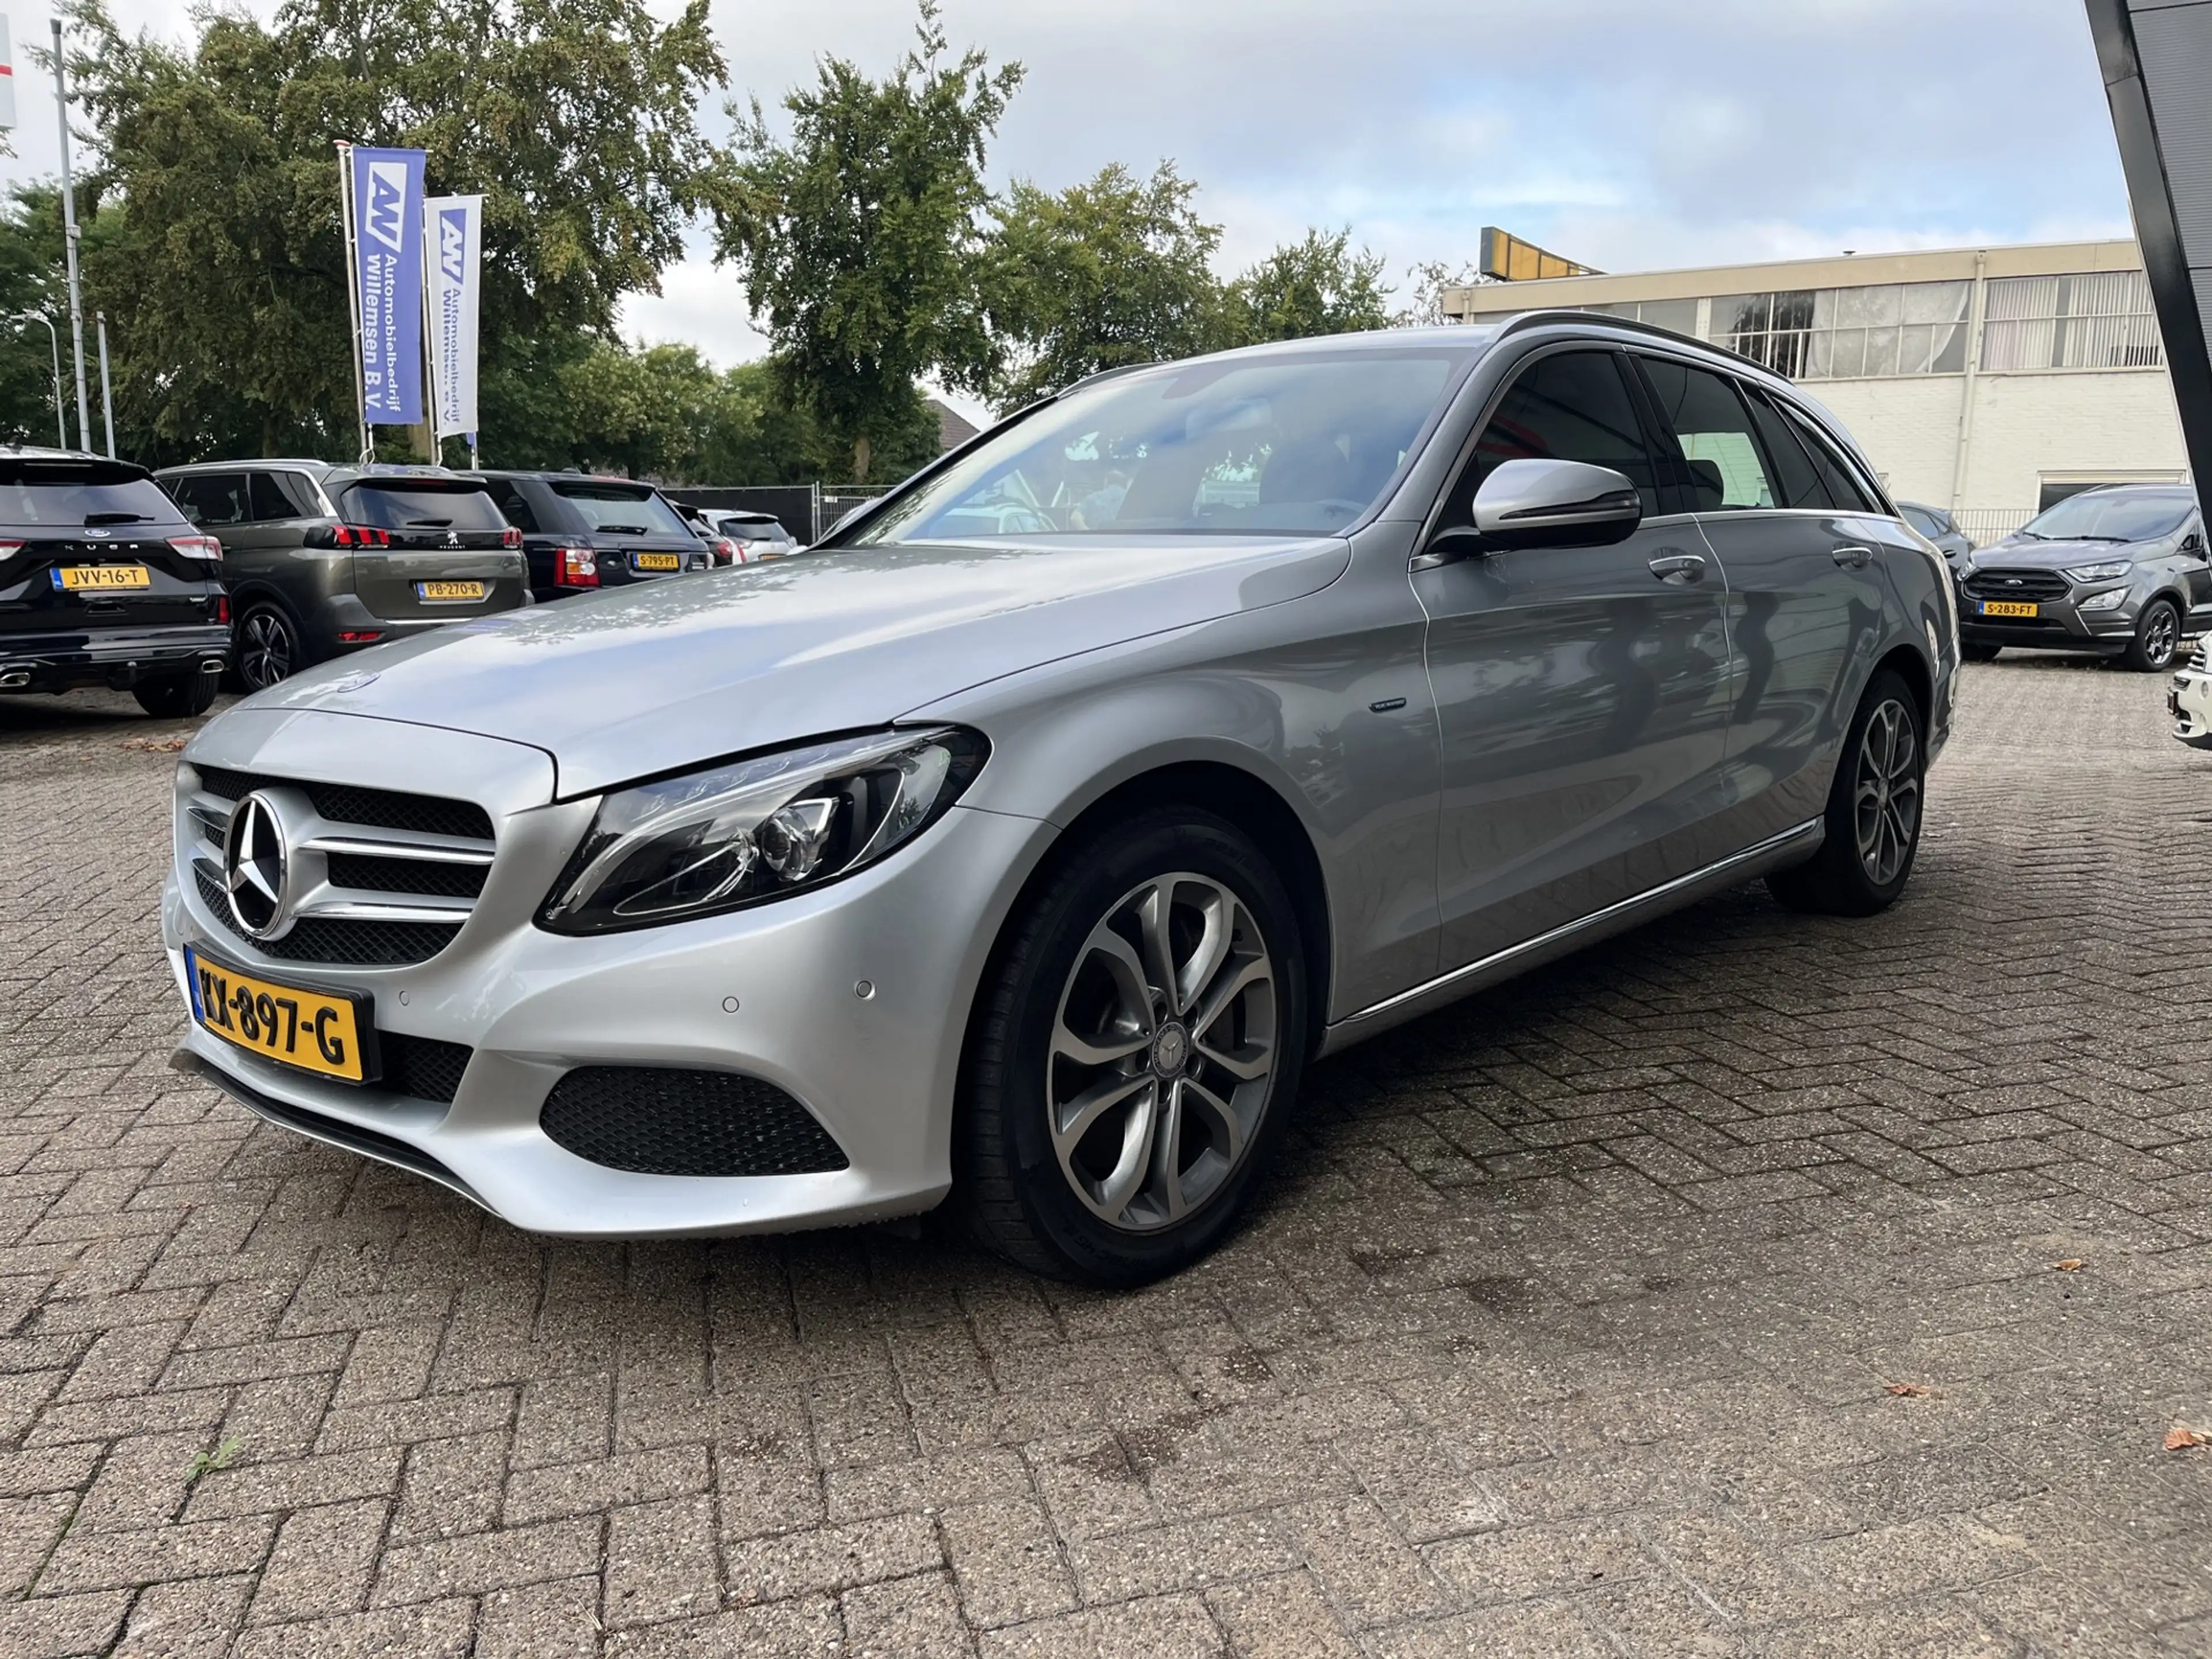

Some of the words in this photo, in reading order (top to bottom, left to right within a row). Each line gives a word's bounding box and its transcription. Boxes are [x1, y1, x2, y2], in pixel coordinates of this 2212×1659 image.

[371, 171, 400, 243] AW
[365, 253, 381, 363] Willemsen
[384, 253, 401, 411] Automobielbedrijf
[450, 288, 461, 423] Automobielbedrijf
[365, 370, 381, 410] B.V.
[72, 570, 138, 585] JVV-16-T
[640, 555, 673, 566] S-795-PT
[427, 583, 479, 594] PB-270-R
[1987, 604, 2032, 614] S-283-FT
